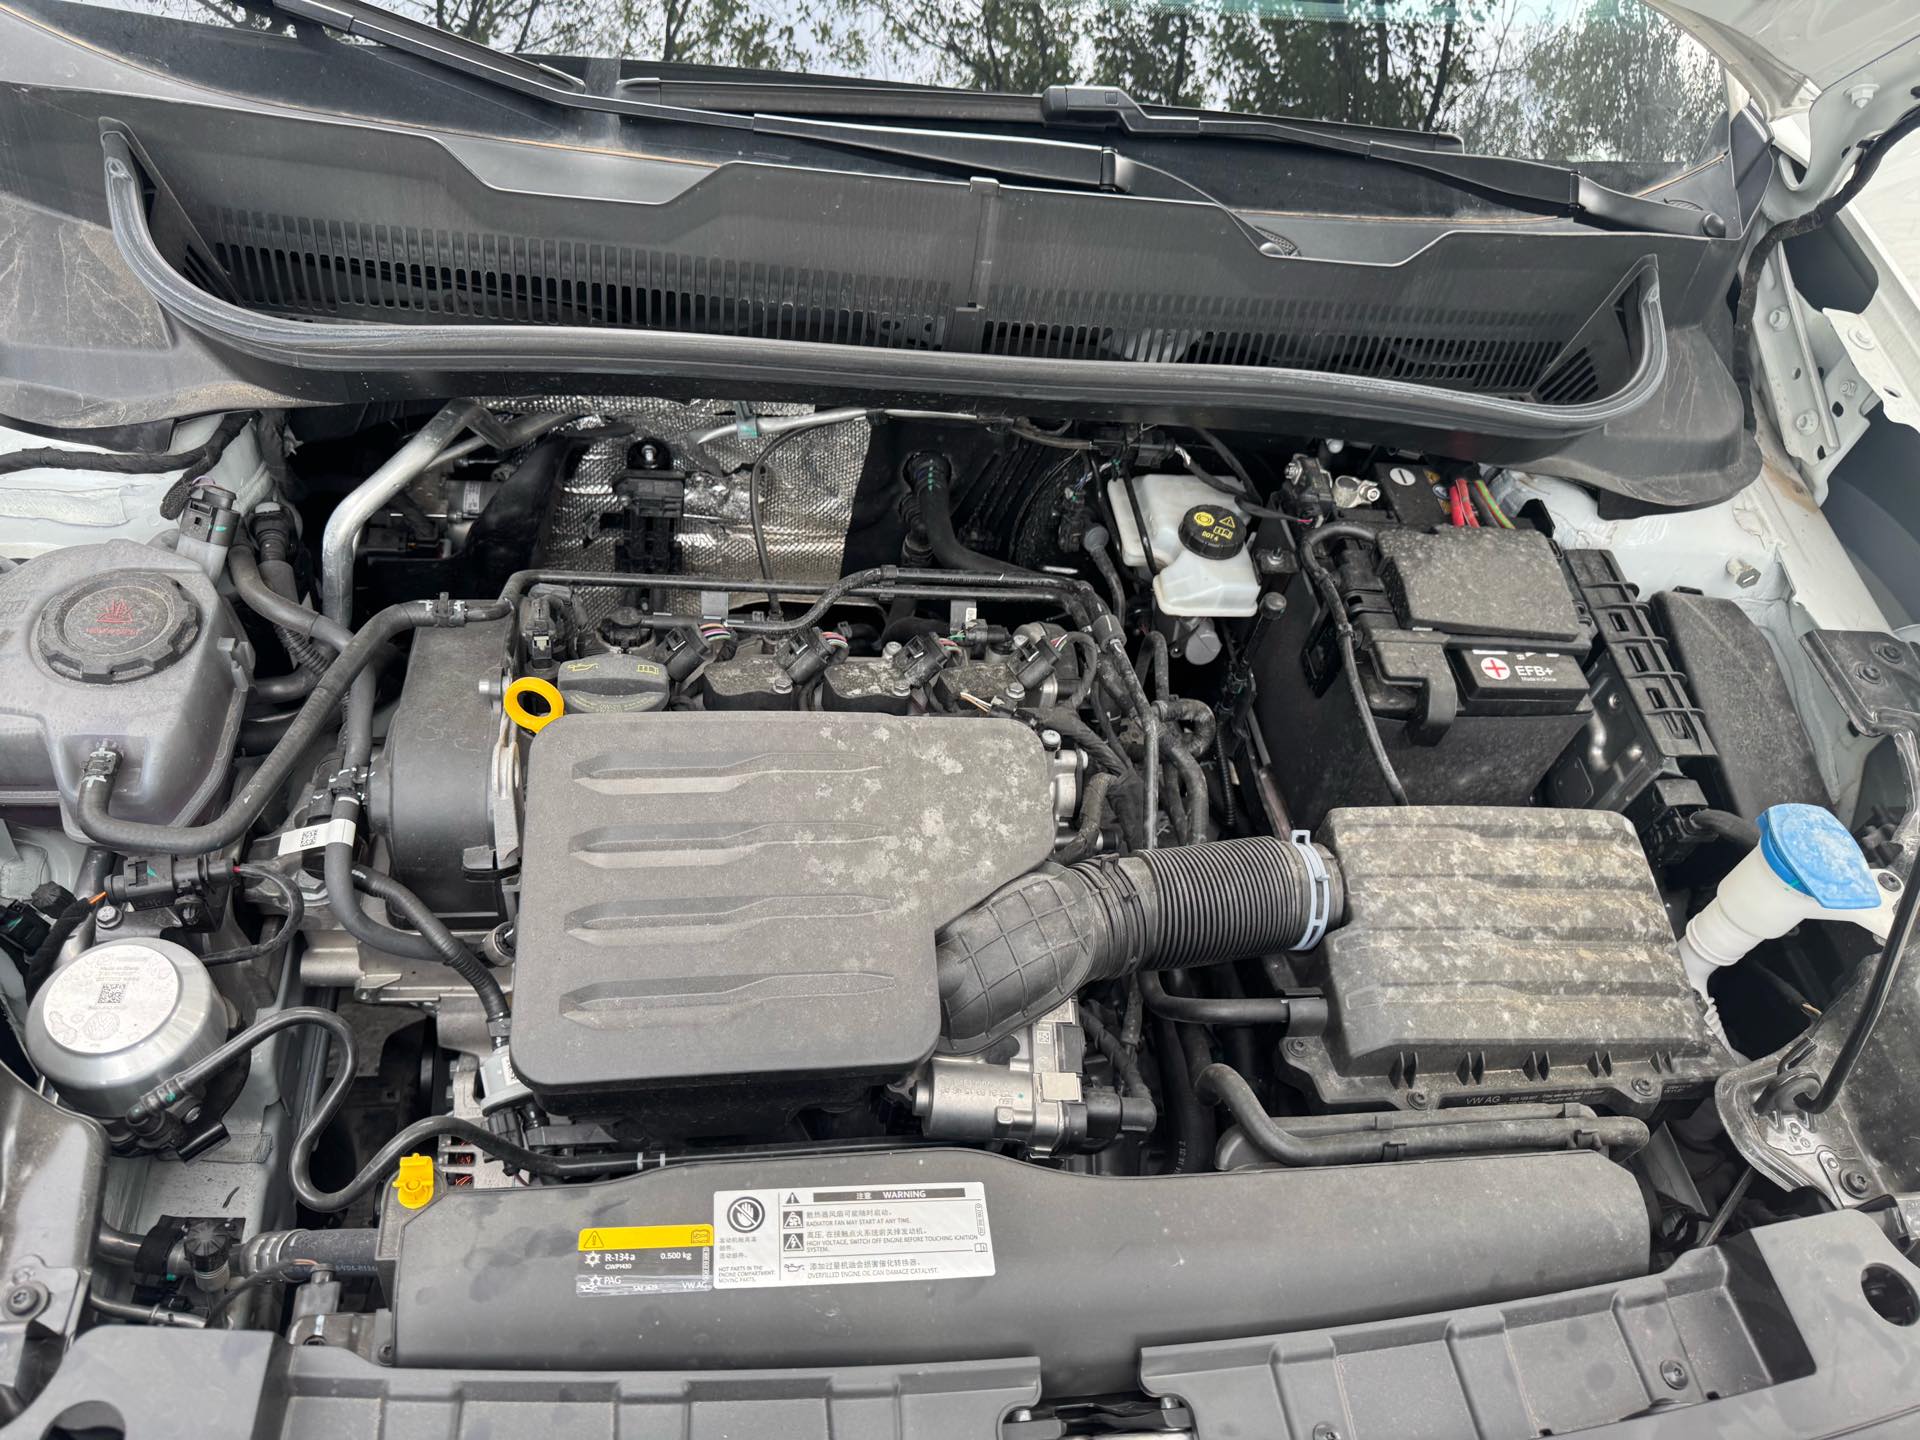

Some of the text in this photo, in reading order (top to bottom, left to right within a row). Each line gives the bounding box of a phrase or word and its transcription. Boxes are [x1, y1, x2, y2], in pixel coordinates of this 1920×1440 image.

[1202, 531, 1214, 539] DOT
[1515, 665, 1554, 676] EFB+
[1466, 1096, 1484, 1105] VW
[1484, 1095, 1501, 1104] AG
[856, 1191, 872, 1200] 注意
[882, 1190, 926, 1199] WARNING
[883, 1236, 903, 1244] ENGINE
[903, 1235, 924, 1243] BEFORE
[925, 1234, 953, 1242] TOUCHING
[954, 1233, 978, 1241] IGNITION
[660, 1251, 692, 1261] 0.500 kg
[807, 1271, 840, 1279] OVERFILLED
[840, 1270, 861, 1278] ENGINE
[604, 1275, 622, 1285] PAG
[682, 1280, 707, 1289] VW AG
